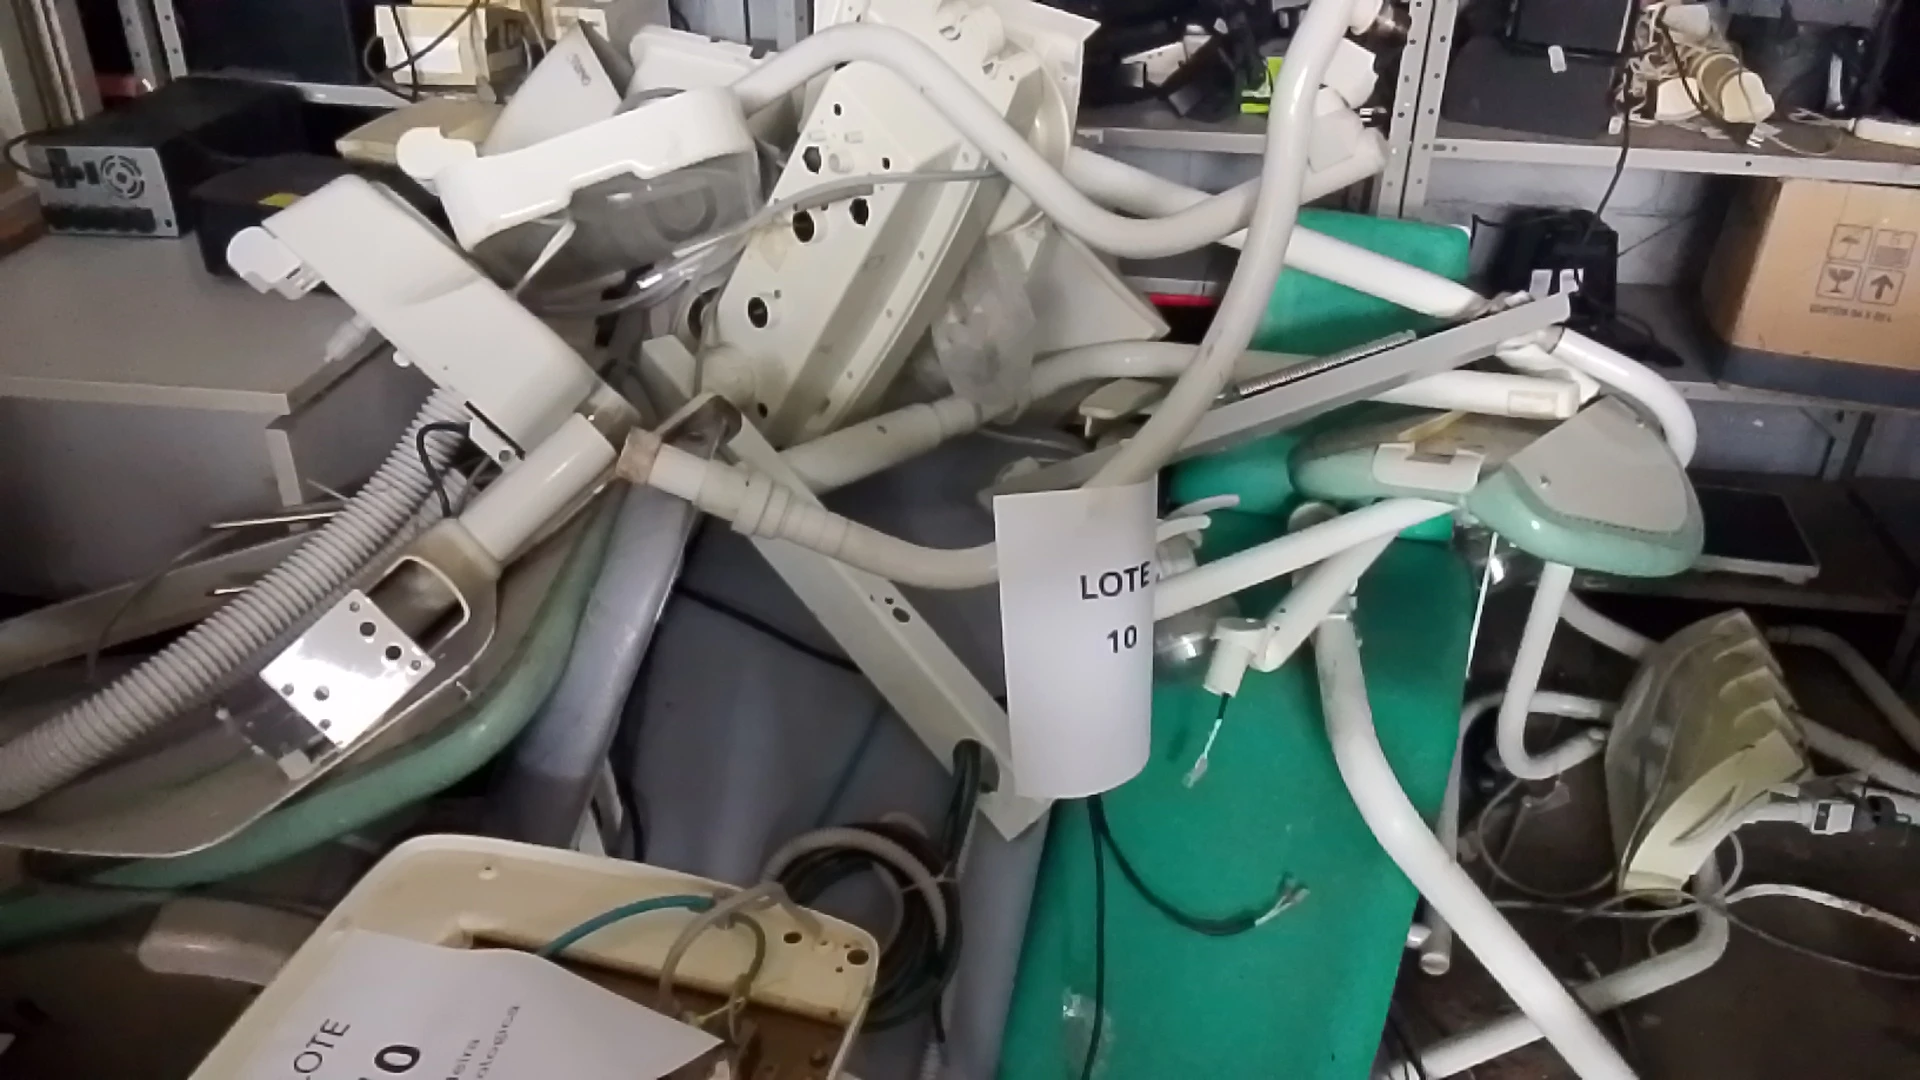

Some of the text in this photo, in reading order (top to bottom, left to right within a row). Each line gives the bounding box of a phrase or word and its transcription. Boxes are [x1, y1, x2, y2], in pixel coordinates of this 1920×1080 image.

[1080, 560, 1151, 601] LOTE
[1106, 624, 1138, 654] 10
[293, 1018, 351, 1080] OTE
[358, 1044, 420, 1080] 0
[444, 1039, 480, 1080] eira
